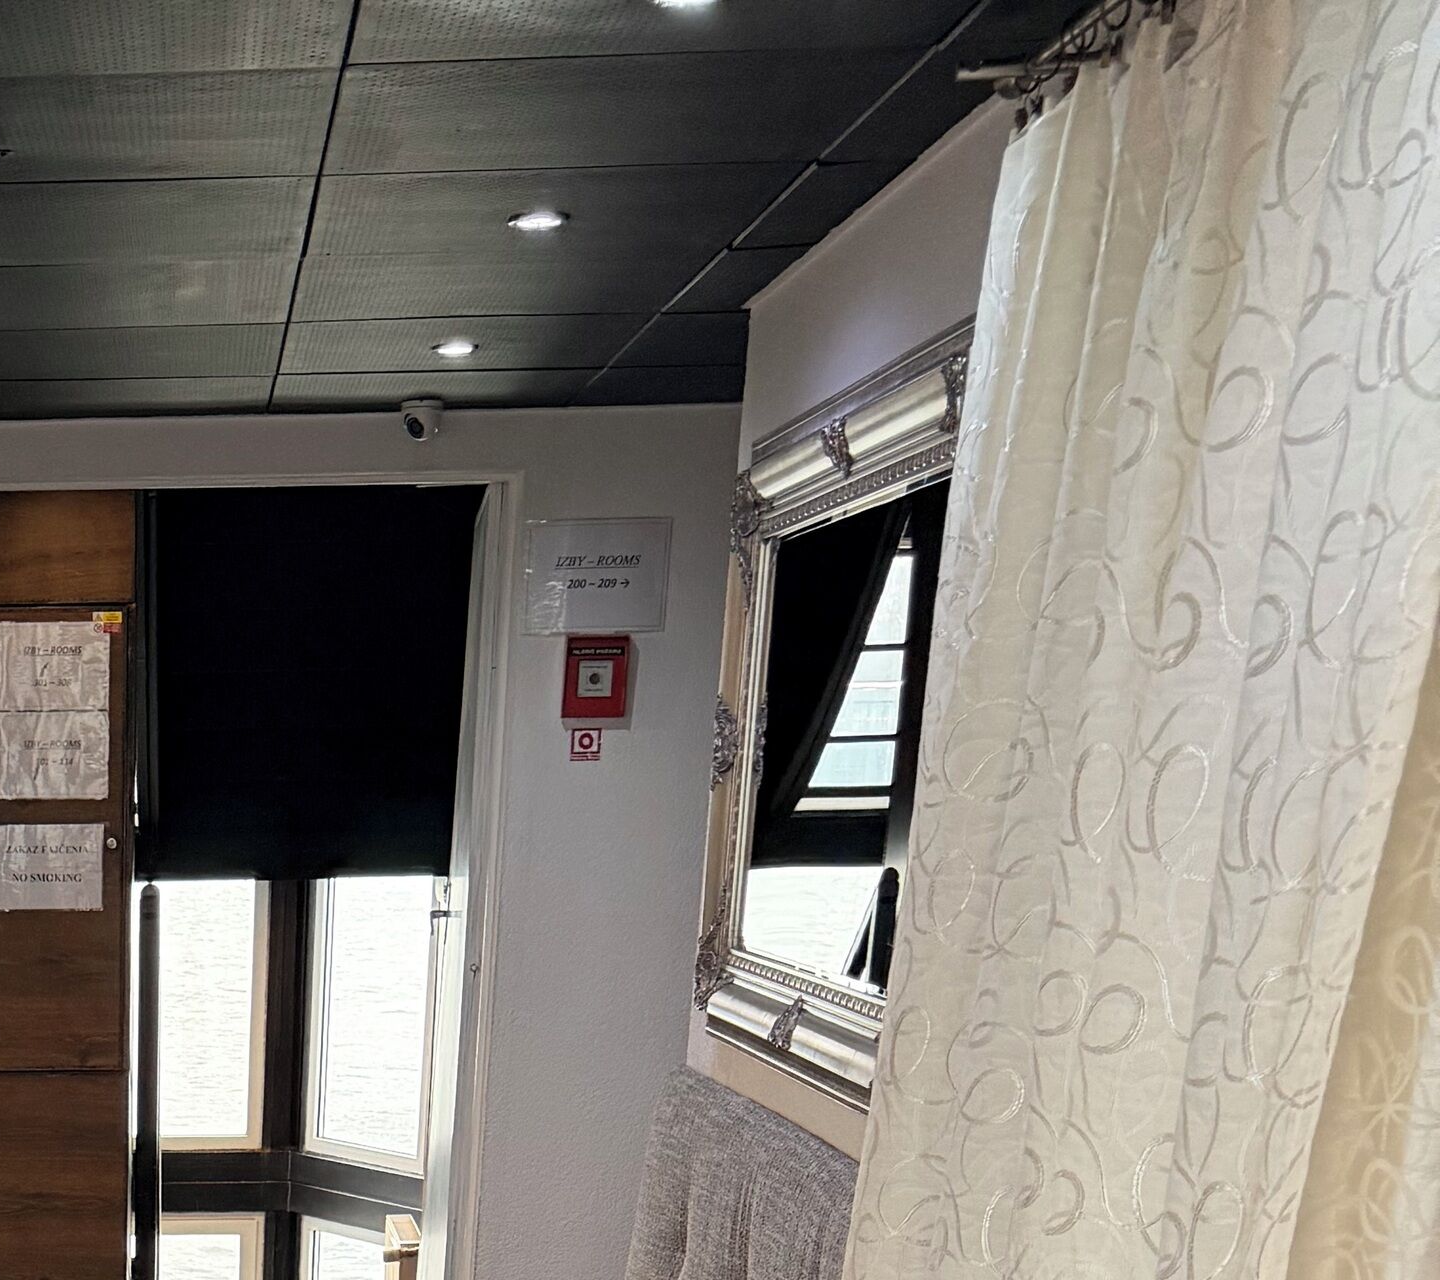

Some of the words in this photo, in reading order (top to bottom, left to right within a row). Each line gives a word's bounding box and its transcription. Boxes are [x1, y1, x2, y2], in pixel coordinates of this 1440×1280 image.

[555, 555, 587, 568] IZBY
[596, 554, 642, 567] ROOMS
[567, 578, 587, 589] 200
[597, 577, 618, 589] 209
[50, 645, 82, 655] ROOMS
[13, 873, 27, 882] NO
[30, 873, 82, 883] SMOKING
